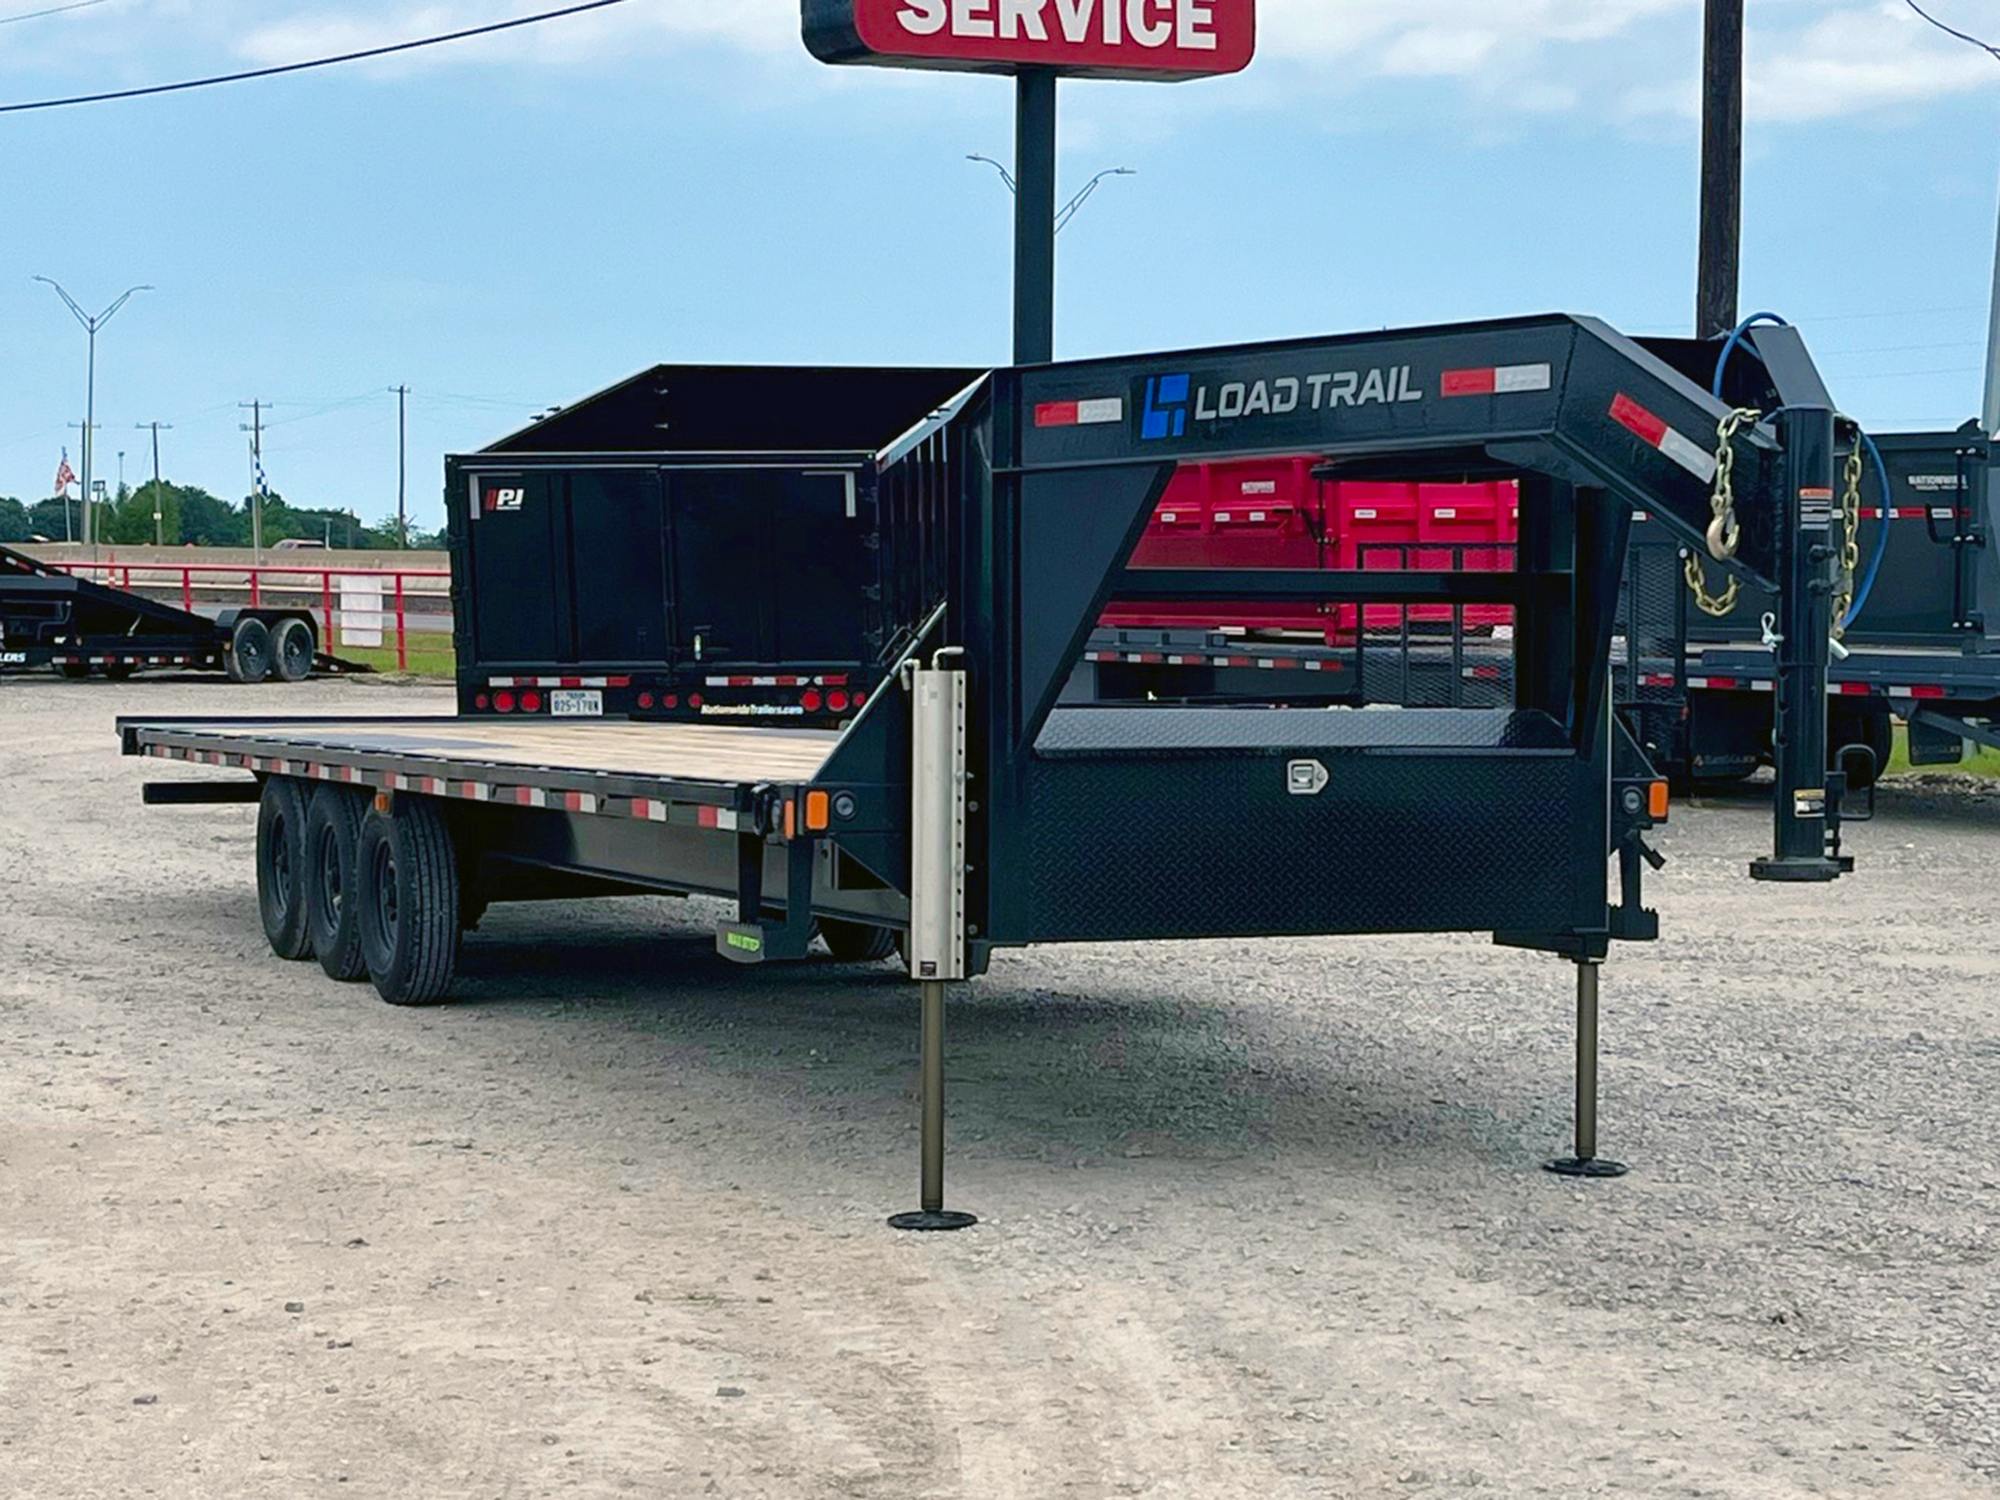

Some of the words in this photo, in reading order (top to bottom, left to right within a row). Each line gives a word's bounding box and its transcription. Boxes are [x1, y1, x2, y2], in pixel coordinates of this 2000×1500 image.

[896, 0, 1217, 50] SERVICE
[1195, 376, 1300, 421] LOAD
[1306, 365, 1424, 410] TRAIL
